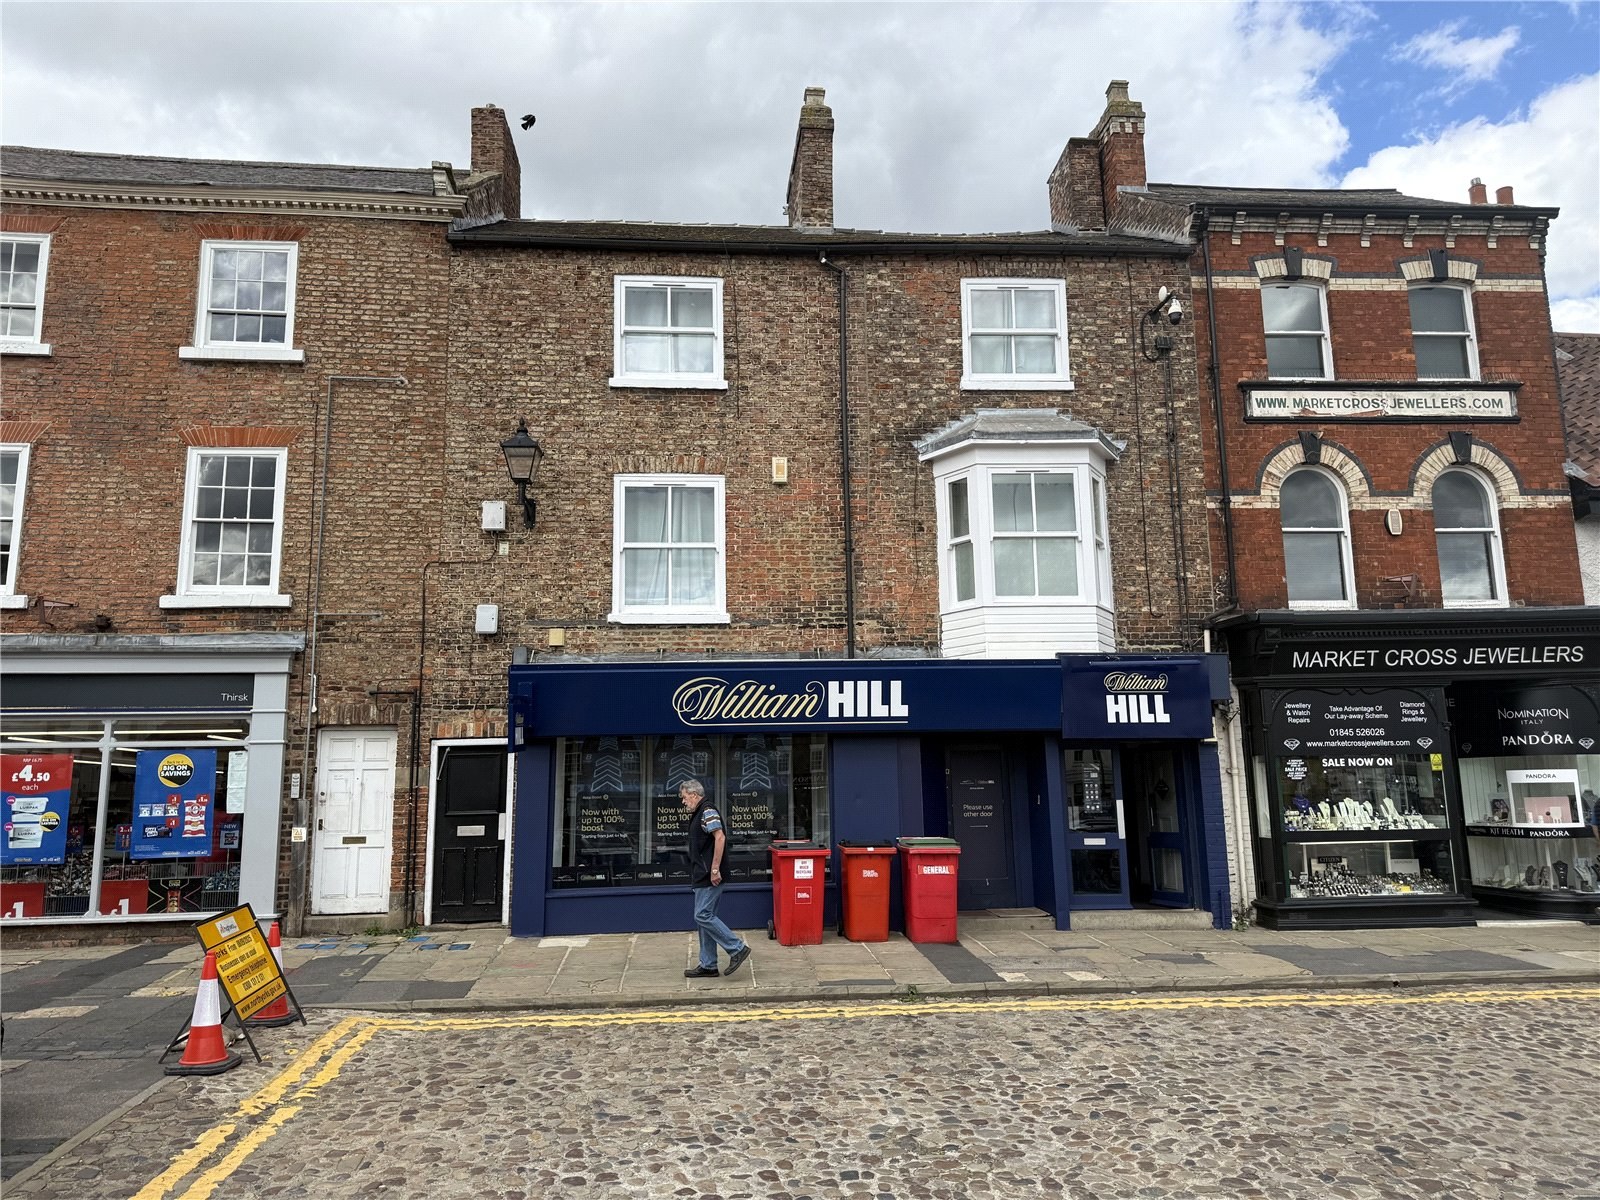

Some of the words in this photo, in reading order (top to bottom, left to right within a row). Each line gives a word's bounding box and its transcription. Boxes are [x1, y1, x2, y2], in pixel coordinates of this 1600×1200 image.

[1293, 650, 1378, 668] MARKET
[1384, 648, 1456, 666] CROSS
[1463, 646, 1584, 664] JEWELLERS
[1104, 672, 1169, 692] William
[221, 692, 248, 702] Thirsk
[672, 676, 825, 723] William
[828, 680, 908, 718] HILL
[1106, 694, 1170, 723] HILL
[1498, 708, 1569, 720] NOMINATION
[1306, 740, 1410, 748] www.marketcrossjewellers.com
[1322, 758, 1345, 767] SALE
[1348, 758, 1374, 766] NOW
[1376, 758, 1393, 766] ON
[12, 765, 50, 782] £4.50
[924, 866, 950, 875] GENERAL
[215, 948, 228, 959] orks
[226, 967, 251, 983] Emergency
[250, 957, 267, 972] telephone
